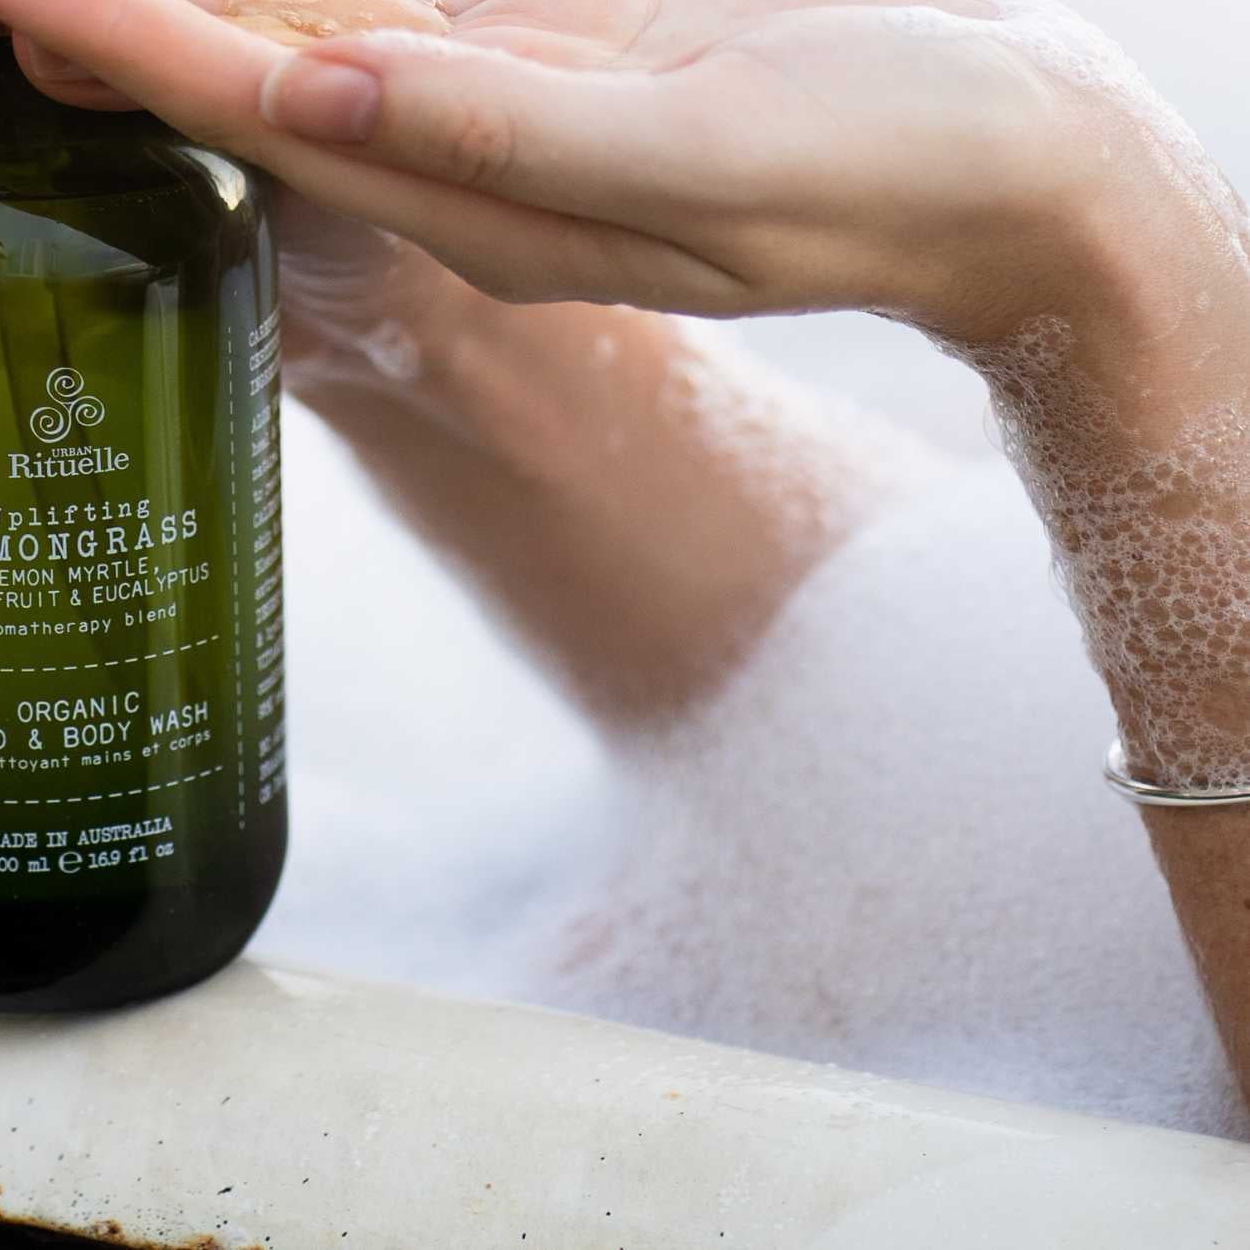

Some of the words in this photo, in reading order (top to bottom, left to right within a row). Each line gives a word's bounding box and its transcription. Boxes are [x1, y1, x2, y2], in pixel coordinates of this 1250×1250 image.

[8, 446, 130, 479] Rituelle
[52, 445, 93, 458] URBAN
[68, 556, 160, 583] MYRTLE,
[70, 589, 82, 606] &
[93, 562, 210, 604] EUCALYPTUS
[125, 602, 177, 627] blend
[17, 691, 140, 723] ORGANIC
[28, 729, 43, 750] &
[64, 720, 132, 748] BODY
[150, 701, 208, 736] WASH
[81, 749, 132, 767] mains
[142, 741, 160, 758] et
[169, 730, 211, 752] corps
[46, 831, 68, 848] IN
[77, 816, 173, 847] AUSTRALIA
[28, 857, 50, 872] ml
[128, 846, 149, 864] fl
[155, 842, 174, 857] oz
